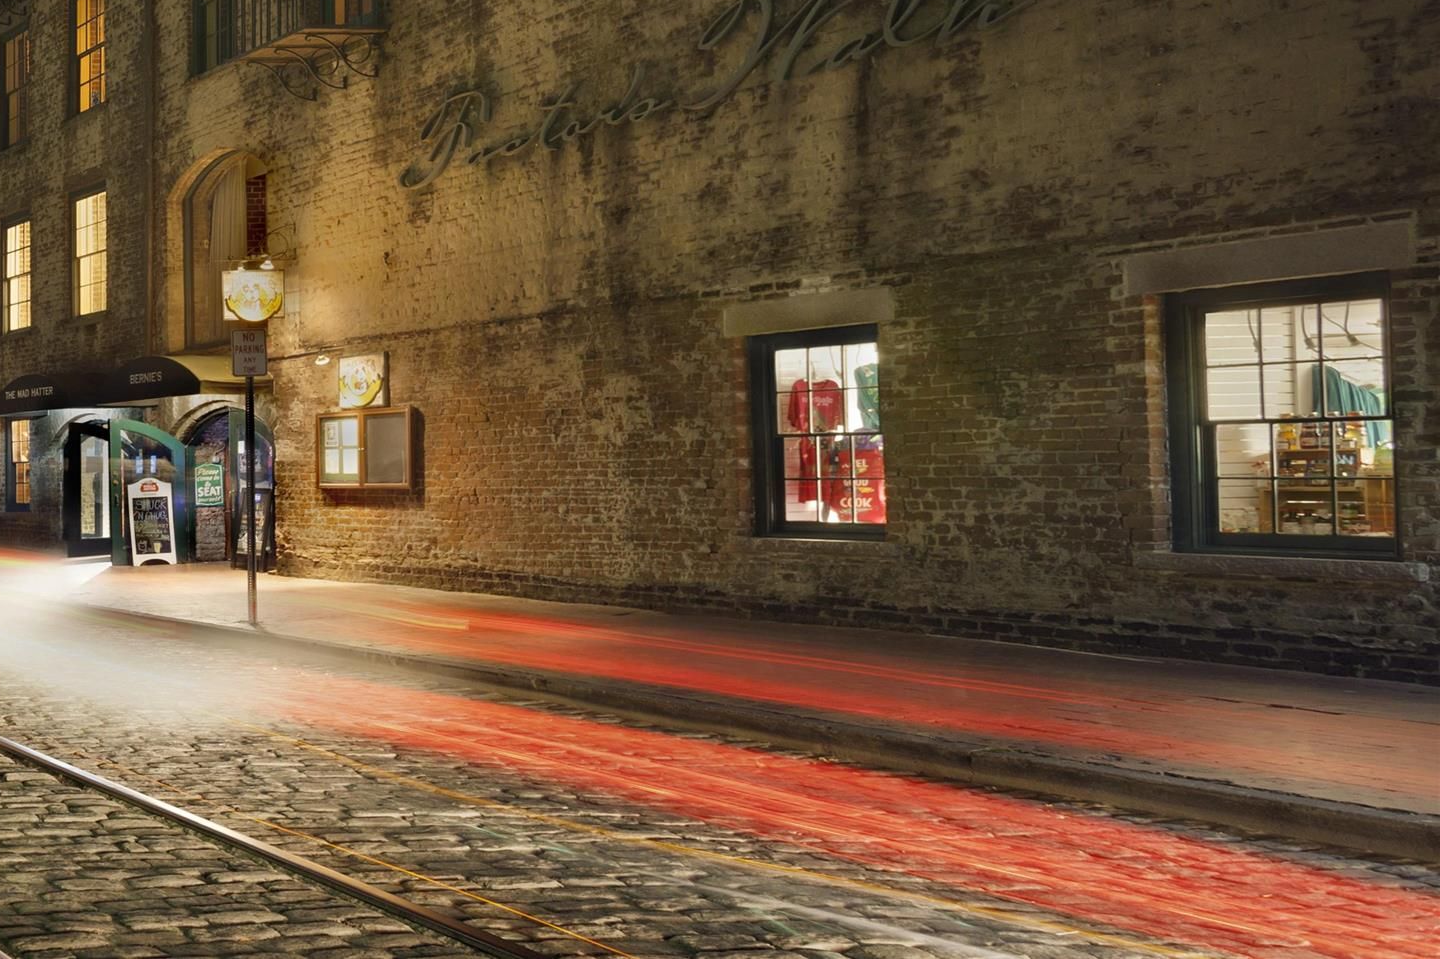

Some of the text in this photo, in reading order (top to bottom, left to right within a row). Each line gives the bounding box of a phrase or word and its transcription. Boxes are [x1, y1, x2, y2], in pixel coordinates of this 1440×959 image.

[242, 332, 256, 342] NO
[234, 344, 265, 354] PARKING
[129, 371, 163, 385] BERNIE'S
[5, 386, 54, 401] THE MAD HATTER
[197, 486, 221, 497] SEAT
